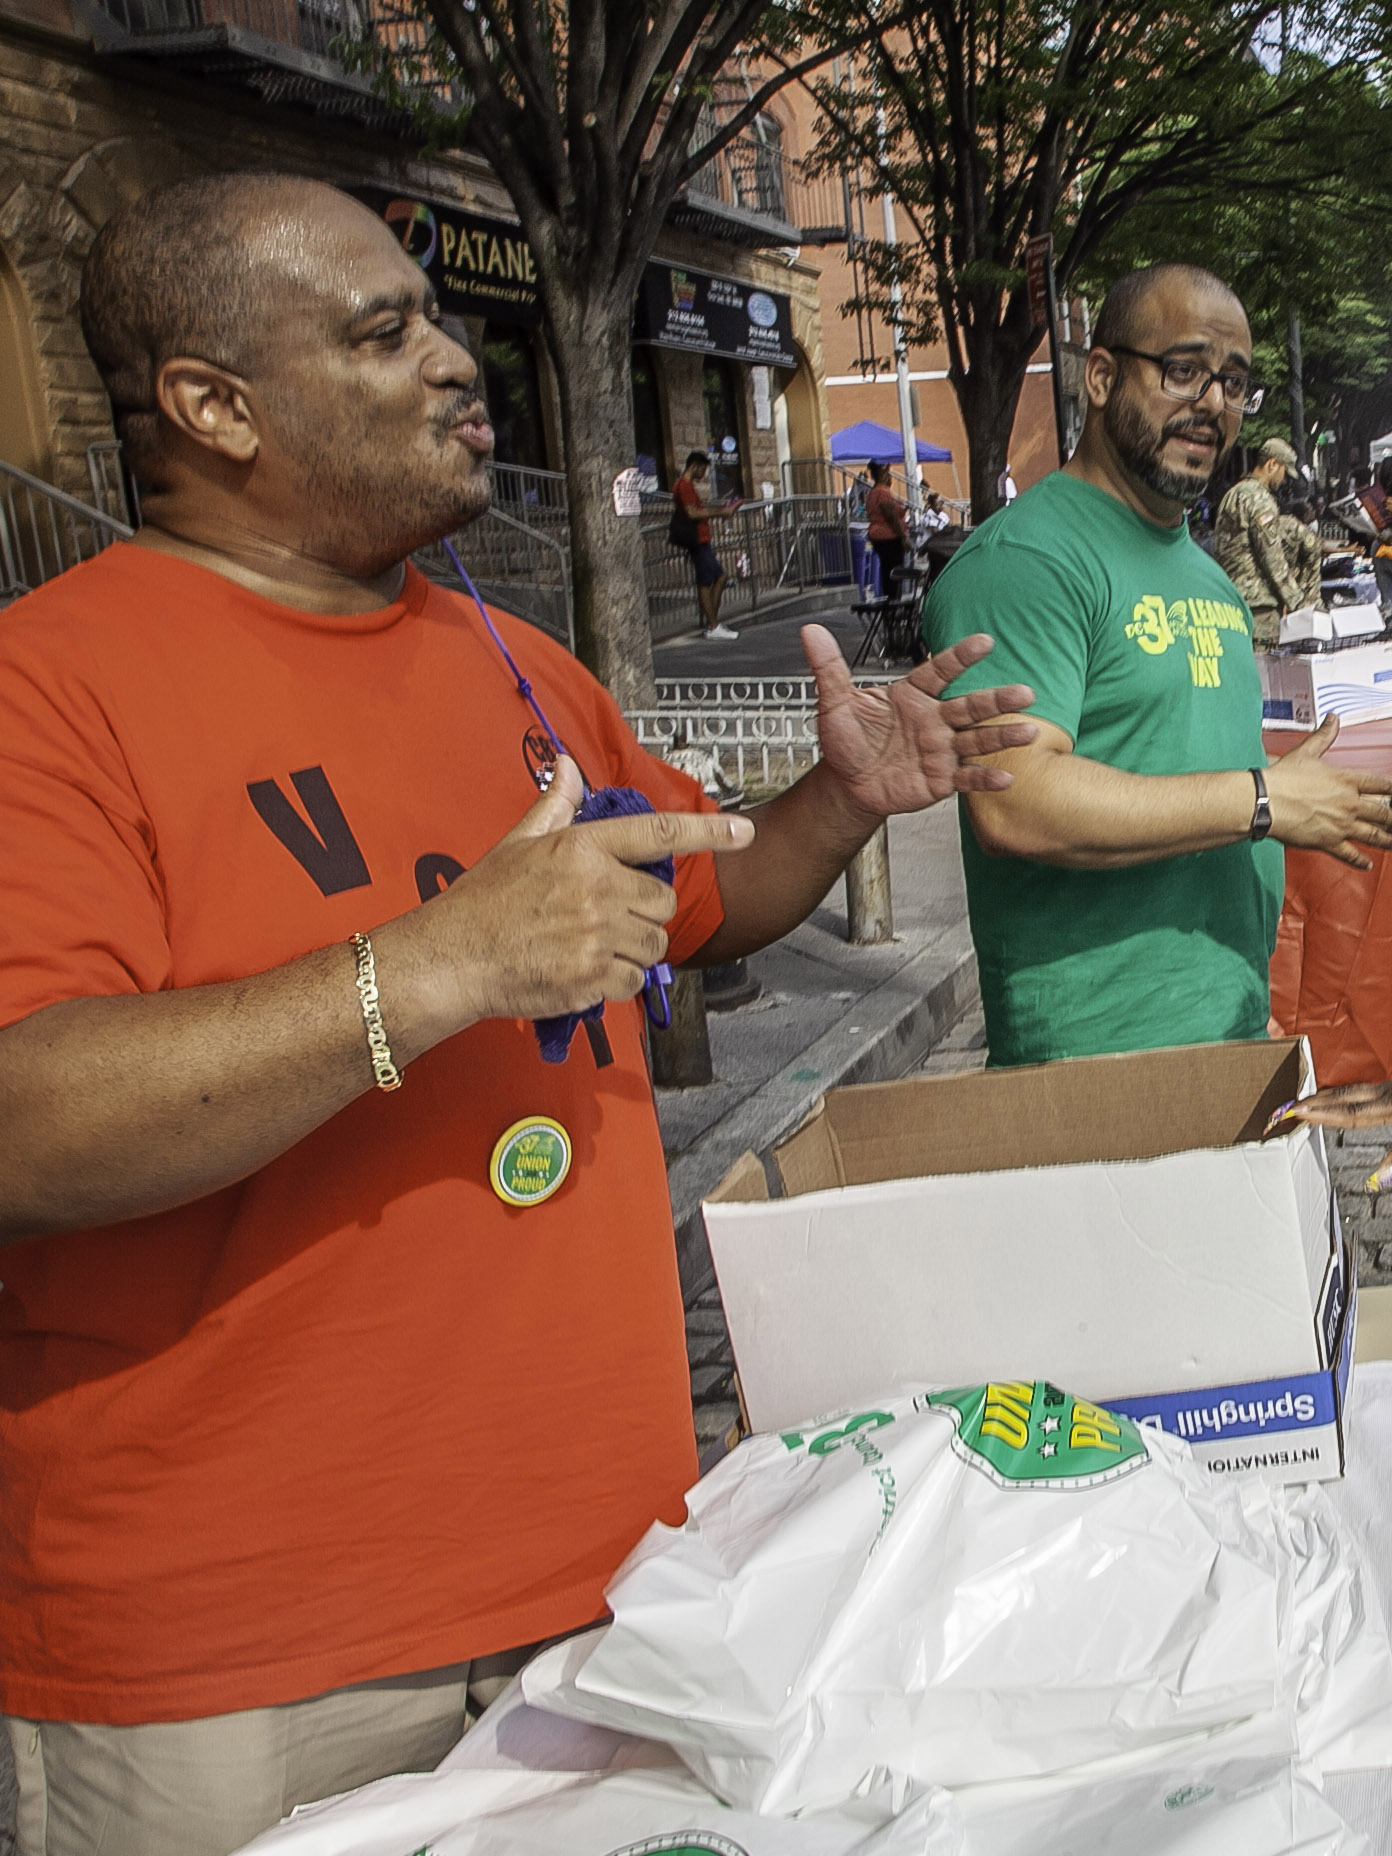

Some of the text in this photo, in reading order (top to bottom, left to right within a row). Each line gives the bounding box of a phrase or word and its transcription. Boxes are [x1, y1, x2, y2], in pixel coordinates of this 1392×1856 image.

[469, 279, 520, 302] Commercial
[1133, 595, 1176, 655] 37
[1187, 597, 1249, 636] LEADING
[1187, 625, 1224, 657] THE
[515, 1153, 551, 1171] UNION
[510, 1175, 547, 1192] PROUD
[1177, 1391, 1315, 1438] Springhill
